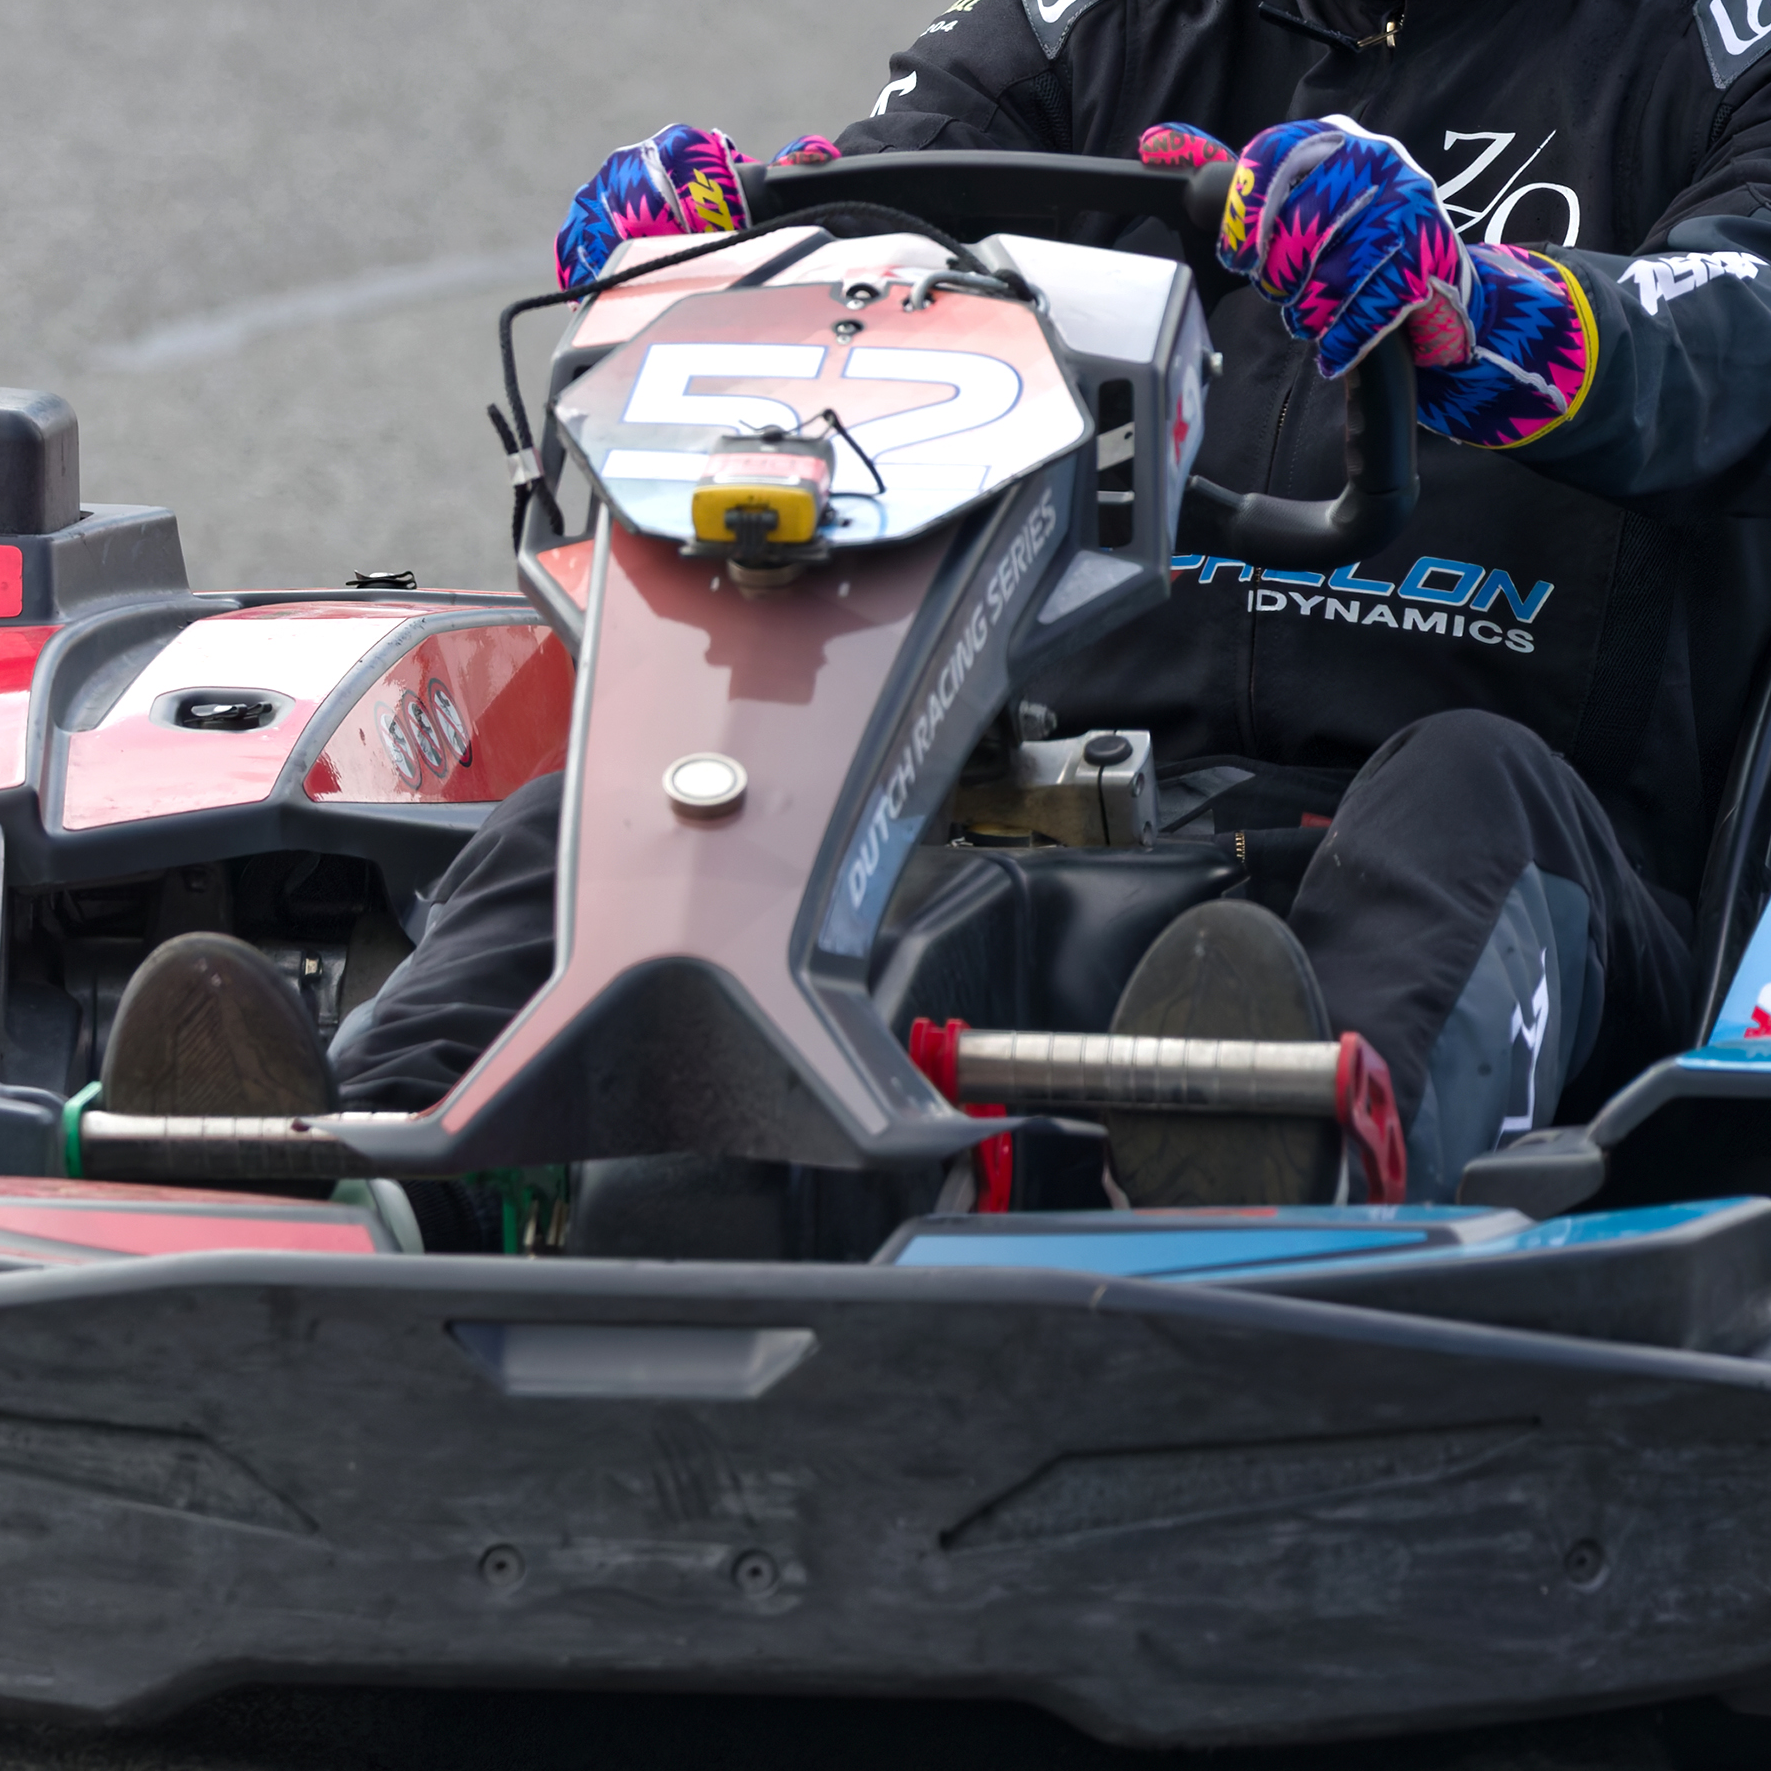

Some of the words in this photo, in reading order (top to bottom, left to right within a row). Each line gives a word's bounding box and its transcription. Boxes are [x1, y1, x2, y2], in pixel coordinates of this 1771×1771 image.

[601, 342, 1023, 491] 52
[1247, 589, 1535, 653] DYNAMICS
[848, 747, 917, 909] DUTCH
[913, 605, 988, 767] RACING
[986, 485, 1058, 626] SERIES
